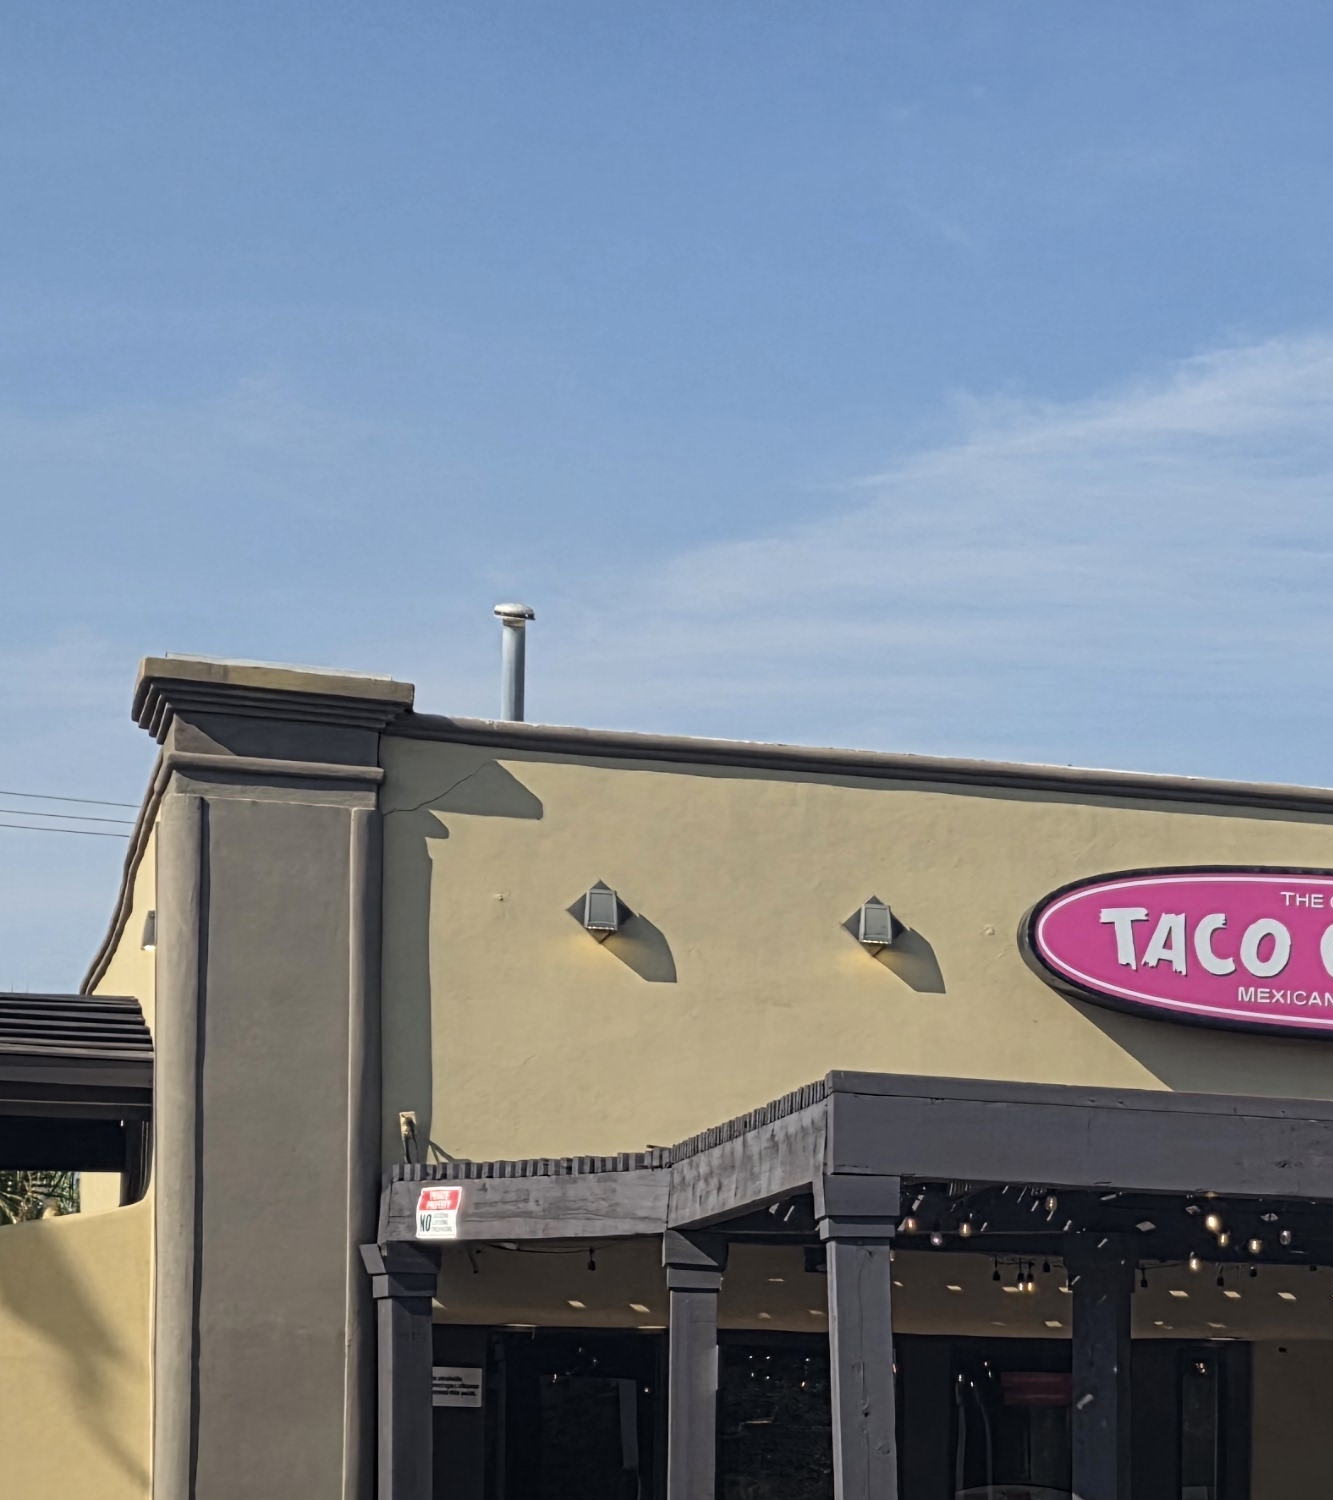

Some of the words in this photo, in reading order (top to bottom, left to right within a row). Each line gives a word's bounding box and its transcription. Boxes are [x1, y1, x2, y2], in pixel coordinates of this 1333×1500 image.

[1280, 891, 1324, 908] THE
[1100, 907, 1292, 977] TACO
[420, 1213, 432, 1232] NO
